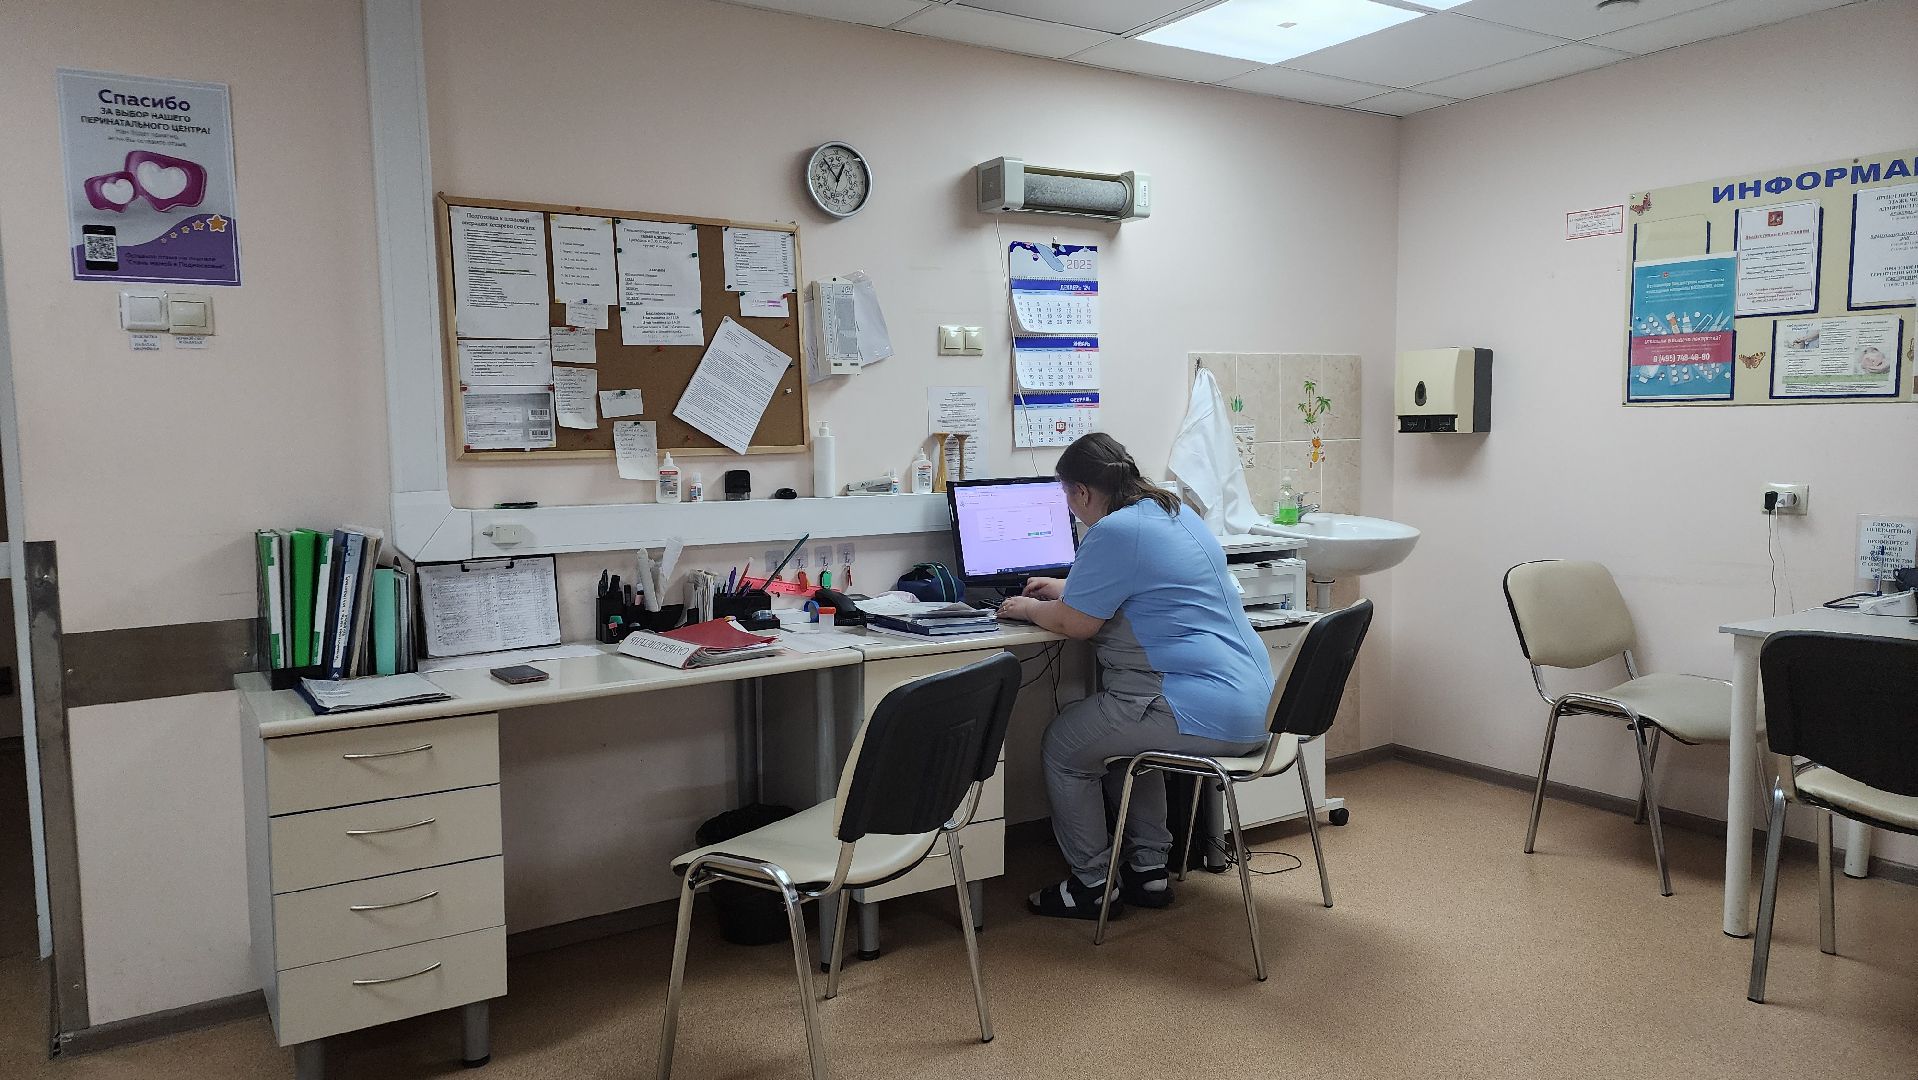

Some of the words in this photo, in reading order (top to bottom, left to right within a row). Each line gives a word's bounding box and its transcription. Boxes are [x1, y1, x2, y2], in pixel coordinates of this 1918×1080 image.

[98, 89, 191, 112] Спасибо
[80, 115, 170, 131] ПЕРИНАТАЛЬНОГО
[171, 124, 211, 135] ЦЕНТРА!
[101, 107, 113, 115] ЗА
[115, 108, 150, 118] ВЫБОР
[151, 112, 192, 123] НАШЕГО
[1712, 156, 1918, 204] ИНФОРМА
